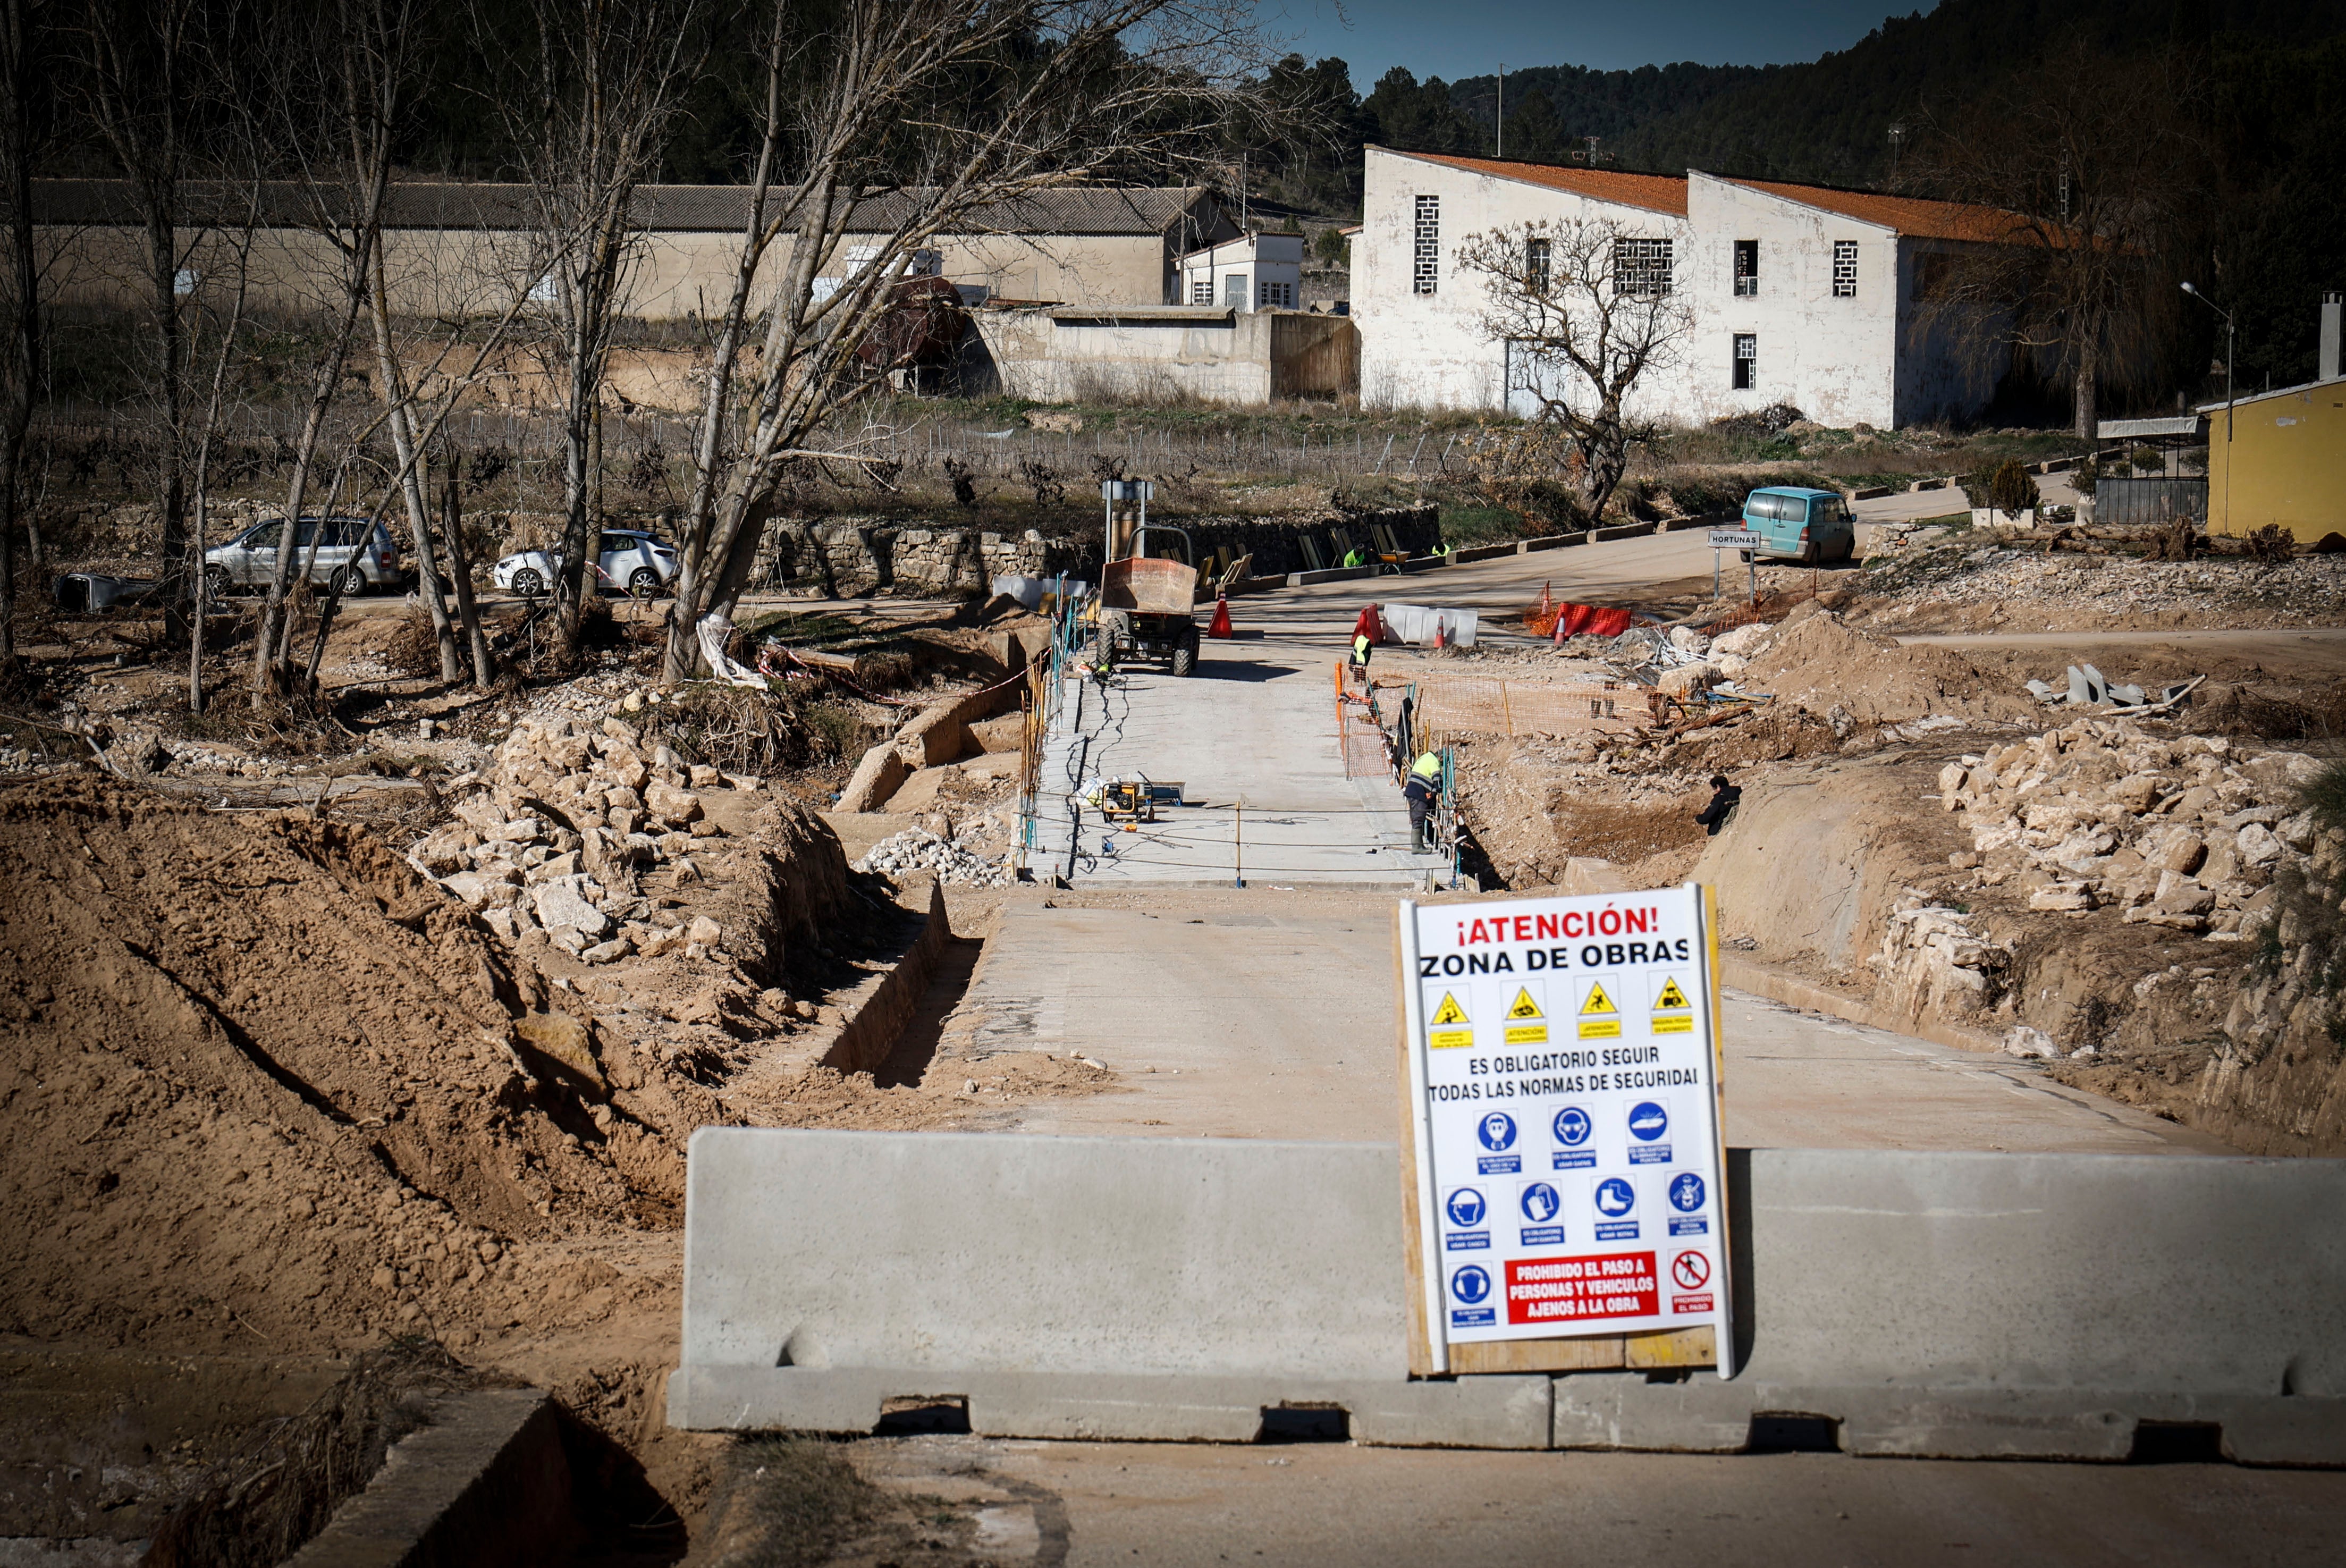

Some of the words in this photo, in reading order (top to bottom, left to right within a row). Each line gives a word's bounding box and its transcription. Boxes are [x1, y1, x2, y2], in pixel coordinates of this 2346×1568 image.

[1457, 903, 1658, 946] ¡ATENCIÓN!
[1420, 952, 1514, 977] ZONA
[1527, 948, 1568, 971] DE
[1582, 939, 1689, 965] OBRAS
[1470, 1058, 1488, 1074] ES
[1495, 1051, 1596, 1073] OBLIGATORIO
[1604, 1047, 1659, 1067] SEGUIR
[1429, 1083, 1480, 1102] TODAS
[1486, 1081, 1514, 1098] LAS
[1521, 1076, 1587, 1095] NORMAS
[1589, 1074, 1608, 1091] DE
[1615, 1067, 1698, 1089] SEGURIDA
[1517, 1262, 1583, 1281] PROHIBIDO
[1584, 1262, 1600, 1277] EL
[1602, 1259, 1634, 1276] PASO
[1635, 1258, 1645, 1274] A
[1509, 1283, 1574, 1300] PERSONAS
[1575, 1280, 1584, 1296] Y
[1586, 1276, 1655, 1295] VEHICULOS
[1673, 1295, 1712, 1304] PROHIBIDO
[1528, 1300, 1575, 1318] AJENOS
[1577, 1299, 1587, 1314] A
[1589, 1298, 1605, 1313] LA
[1606, 1296, 1640, 1313] OBRA
